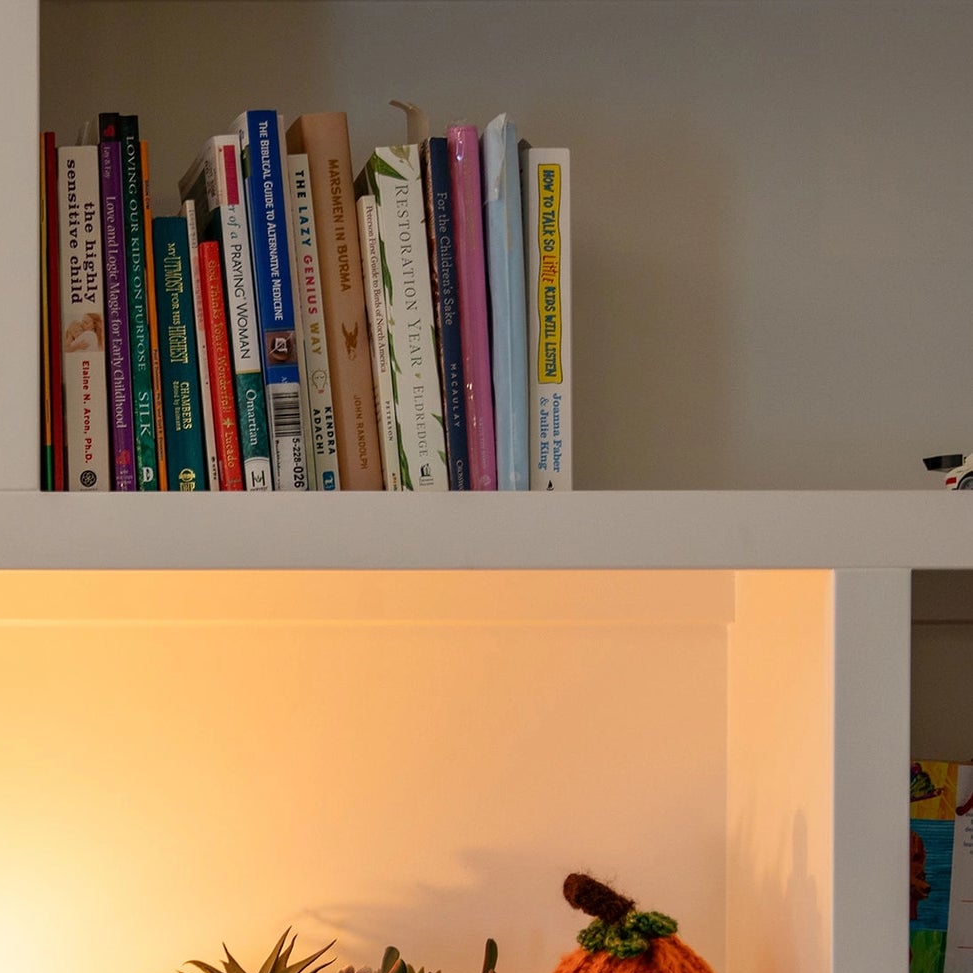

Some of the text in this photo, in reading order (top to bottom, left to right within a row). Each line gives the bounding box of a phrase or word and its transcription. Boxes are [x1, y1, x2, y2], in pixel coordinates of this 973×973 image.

[543, 170, 555, 192] HOW
[543, 196, 554, 208] TO
[67, 160, 82, 304] sensitive child
[228, 216, 240, 228] of
[258, 120, 283, 321] THE BIBLICAL GUIDE TO ALTERNATIVE MEDICINE
[328, 159, 351, 292] MARSMEN IN BURMA
[366, 206, 376, 237] Peterson
[543, 210, 556, 236] TALK
[83, 202, 97, 304] the highly
[125, 136, 146, 372] LOVING OUR KIDS ON PURPOSE
[295, 170, 321, 355] THE LAZY GENIUS WAY
[368, 239, 378, 255] First
[437, 192, 455, 326] For the Children's Sake
[543, 239, 555, 252] SO
[163, 256, 183, 294] UTMOST
[231, 244, 244, 297] PRAYING
[370, 256, 379, 278] Guide
[373, 280, 380, 288] to
[395, 185, 423, 368] RESTORATION YEAR
[105, 196, 127, 429] Love and Logic Magic for Early Childhood
[171, 294, 179, 310] FOR
[172, 312, 181, 325] HIS
[210, 285, 221, 319] Thinks
[374, 289, 382, 310] Birds
[545, 286, 556, 312] KIDS
[168, 325, 188, 364] HIGHEST
[236, 303, 251, 359] WOMAN
[377, 318, 386, 341] North
[545, 315, 556, 338] WILL
[378, 343, 387, 373] America
[545, 342, 557, 377] LISTEN
[82, 361, 93, 464] Elaine N. Aron, Ph.D.
[138, 392, 151, 436] SILK
[180, 382, 192, 430] CHAMBERS
[450, 363, 460, 428] MACAULAY
[245, 389, 259, 446] Omartian
[313, 409, 323, 455] ADACHI
[325, 406, 335, 455] KENDRA
[353, 395, 368, 470] JOHN RANDOLPH
[385, 401, 393, 442] PETERSON
[413, 386, 428, 457] ELDREDGE
[538, 397, 549, 470] & Julie King
[552, 393, 562, 473] Joanna Faber
[224, 432, 235, 469] Lucado
